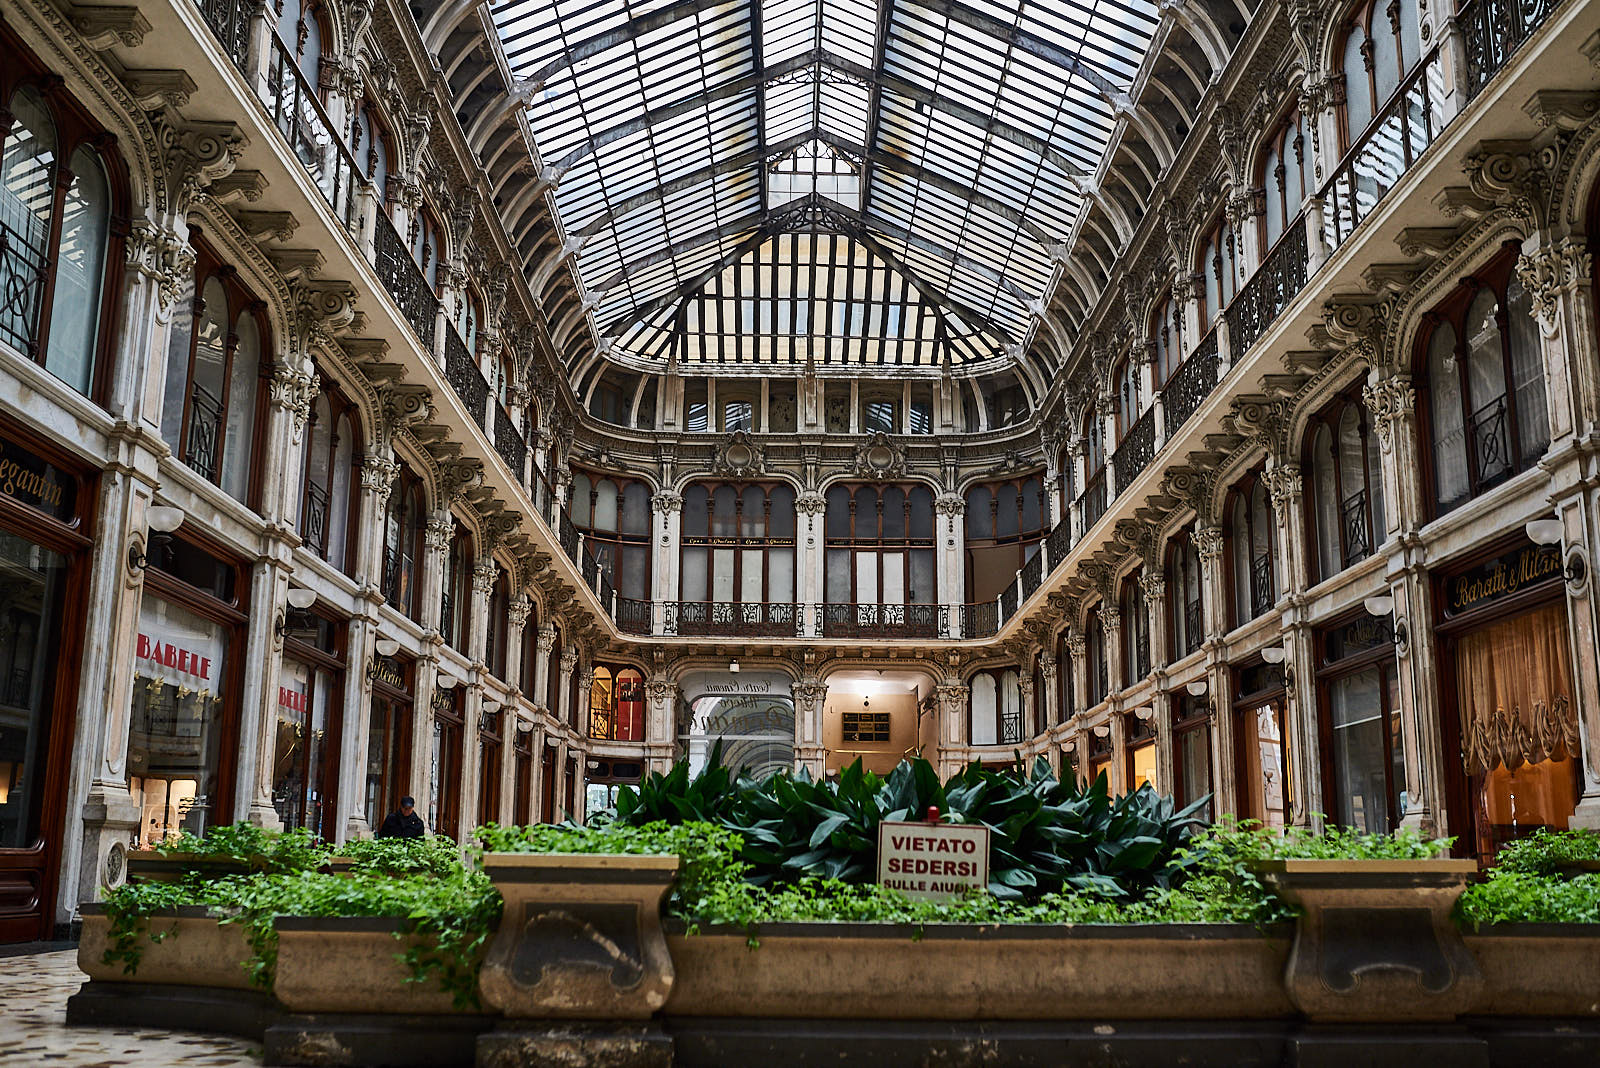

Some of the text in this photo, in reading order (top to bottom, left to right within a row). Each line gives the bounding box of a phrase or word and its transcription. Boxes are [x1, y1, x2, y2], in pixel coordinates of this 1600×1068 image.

[1454, 564, 1508, 607] Baratti
[1508, 548, 1562, 593] Milan
[136, 633, 211, 680] BABELE
[278, 686, 308, 713] BELE
[891, 836, 975, 854] VIETATO
[888, 858, 977, 877] SEDERSI
[884, 879, 926, 891] SULLE
